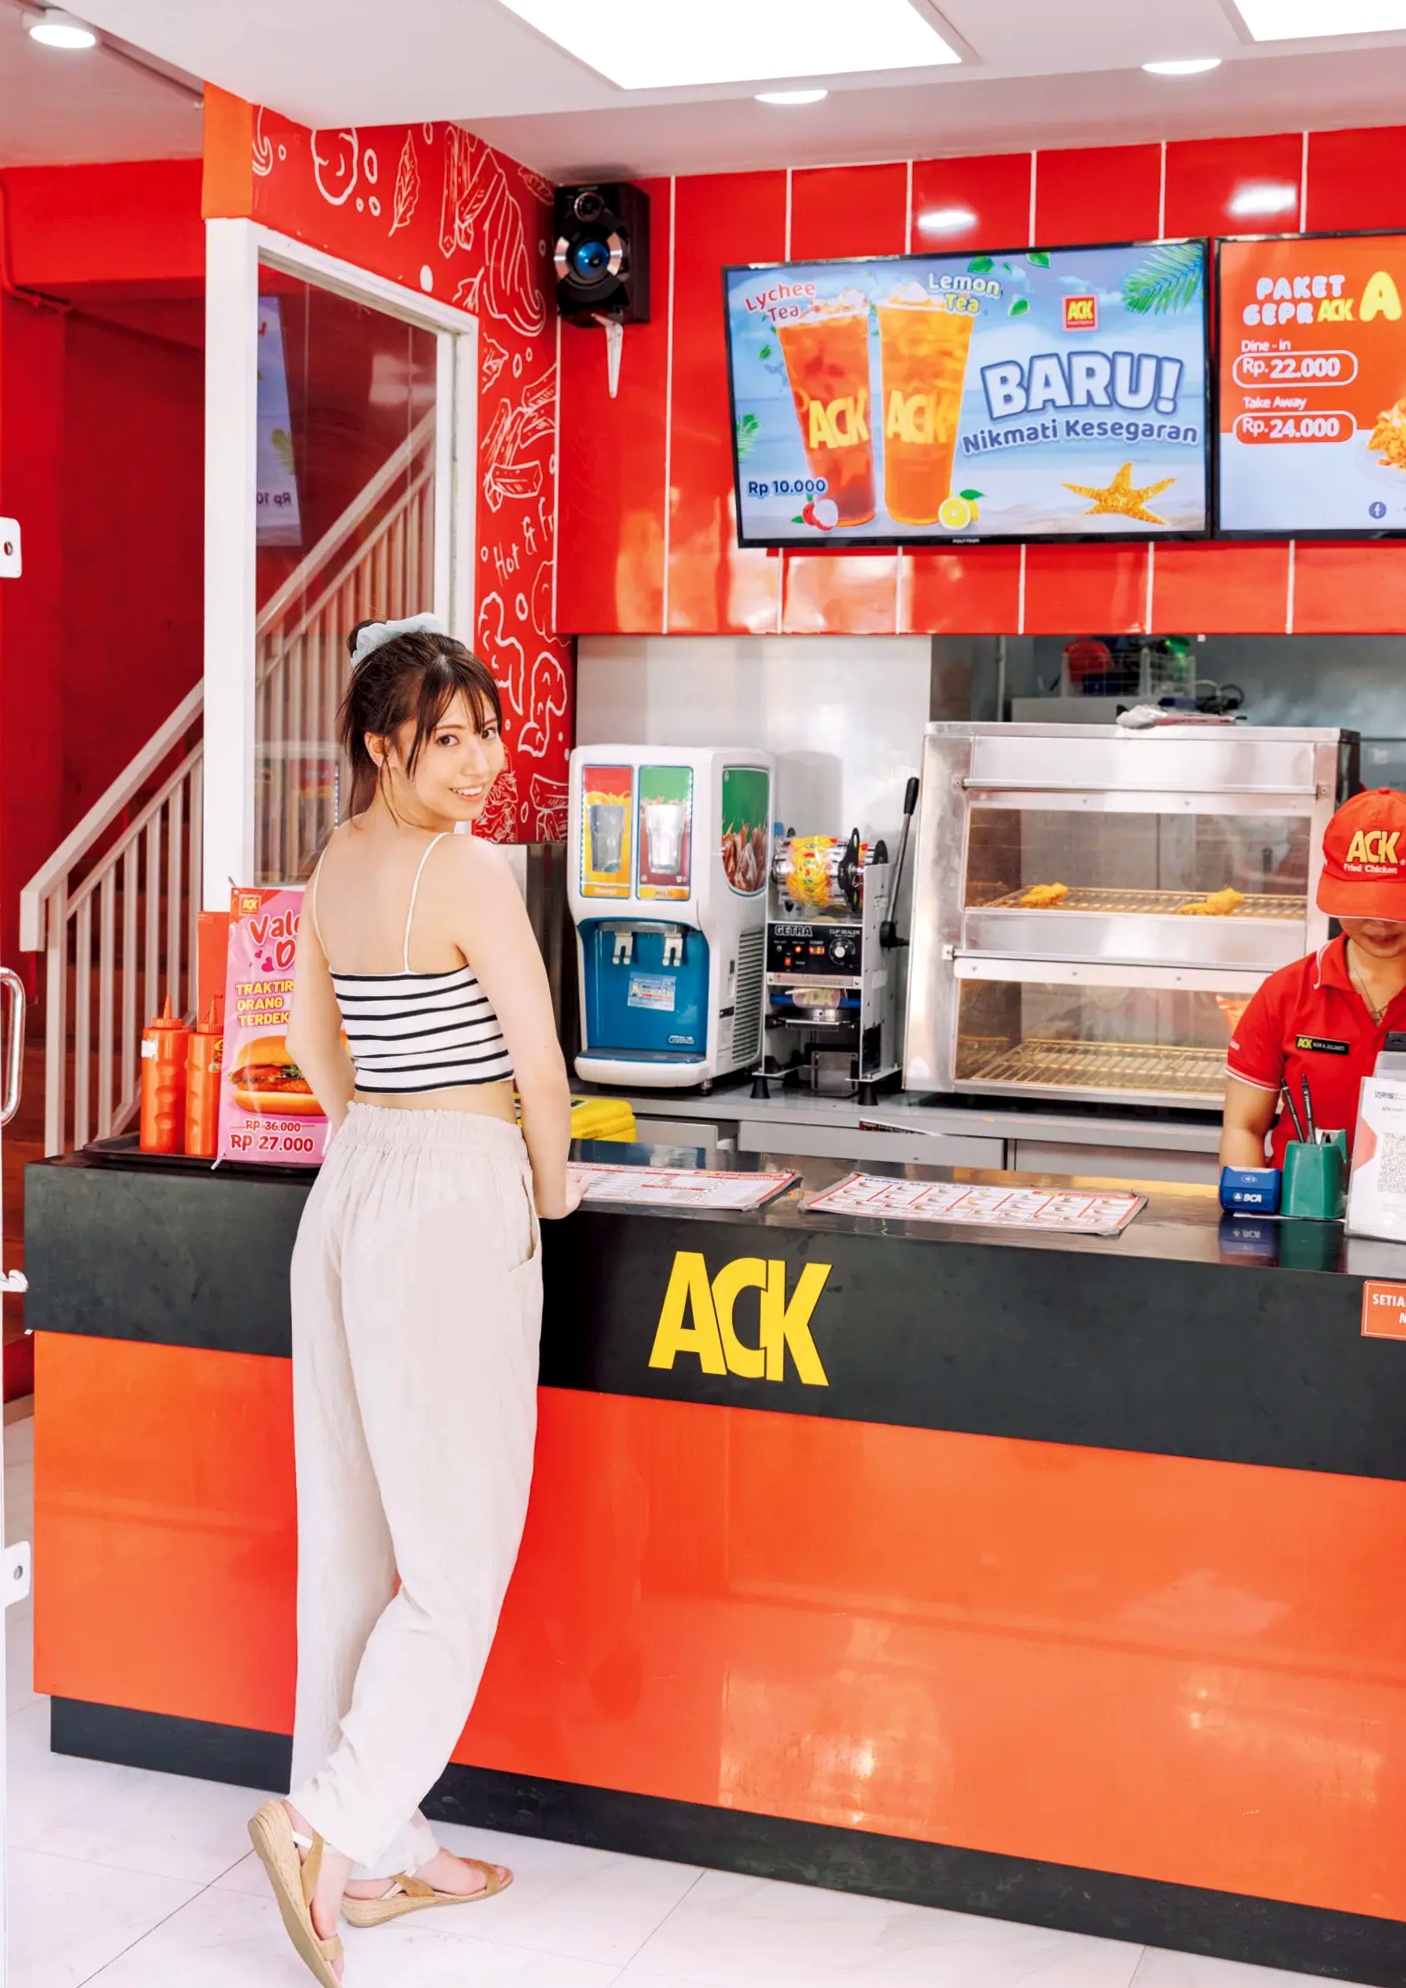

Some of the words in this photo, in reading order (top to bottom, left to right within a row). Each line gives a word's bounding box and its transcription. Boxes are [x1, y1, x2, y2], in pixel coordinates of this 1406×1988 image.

[927, 273, 1001, 297] Lemon
[1256, 274, 1346, 301] PAKET
[745, 282, 816, 312] Lychee
[944, 294, 980, 314] Tea
[1359, 270, 1402, 322] A
[767, 304, 799, 322] Tea
[1067, 300, 1094, 320] ACK
[1241, 339, 1270, 352] Dine
[1279, 339, 1291, 351] in
[1270, 357, 1341, 378] 22.000
[981, 351, 1184, 421] BARU!
[1242, 396, 1270, 410] Take
[1273, 396, 1307, 411] Away
[809, 391, 870, 449] ACK
[886, 389, 952, 445] ACK
[962, 420, 1059, 454] Nikmati
[1064, 419, 1198, 446] Kesegaran
[1270, 417, 1341, 438] 24.000
[748, 480, 769, 498] Rp
[772, 479, 826, 494] 10.000
[493, 541, 521, 588] Hot
[1345, 830, 1400, 864] ACK
[1343, 863, 1362, 872] Fried
[1364, 864, 1398, 874] Chicken
[774, 925, 813, 937] GETRA
[235, 979, 294, 996] TRAKTIR
[236, 996, 284, 1012] ORANG
[238, 1010, 290, 1027] TERDEK
[1297, 1037, 1312, 1049] ACK
[265, 1121, 301, 1132] 36.000
[258, 1136, 314, 1152] 27.000
[1243, 1194, 1262, 1203] BCA
[1372, 1293, 1406, 1308] SETIA
[648, 1250, 833, 1387] ACK
